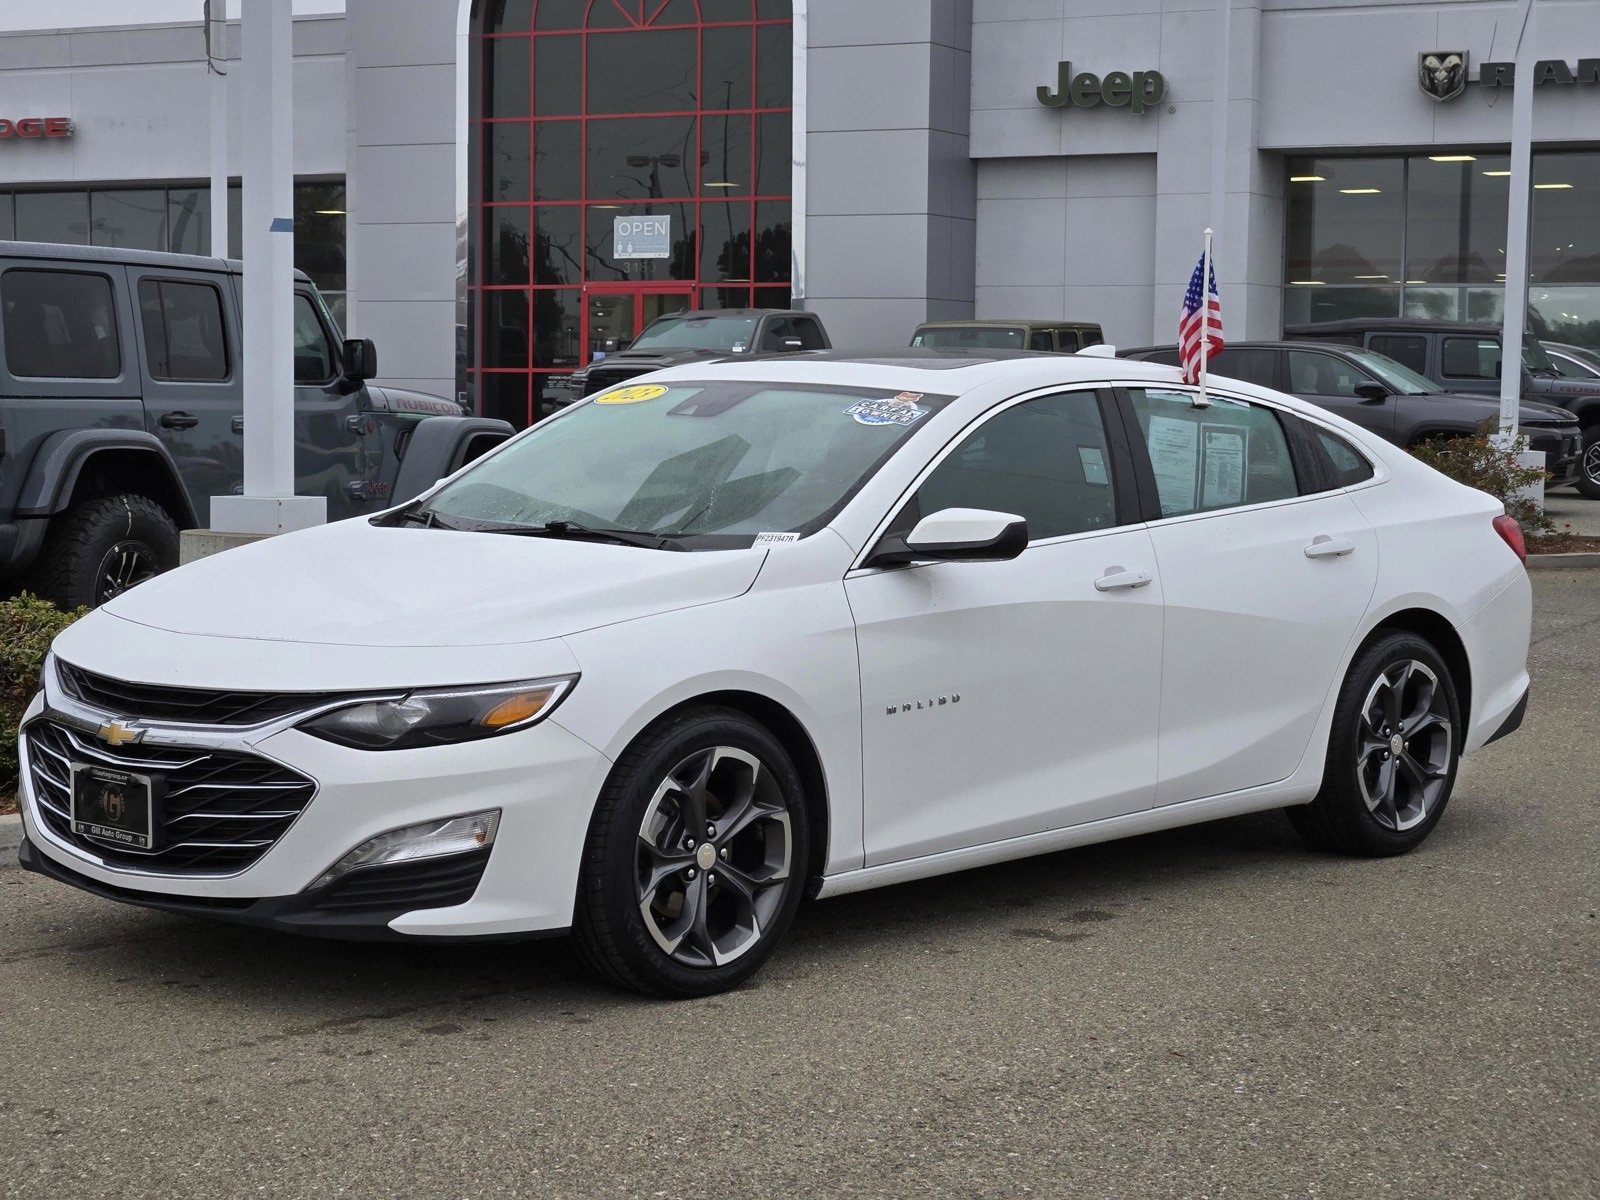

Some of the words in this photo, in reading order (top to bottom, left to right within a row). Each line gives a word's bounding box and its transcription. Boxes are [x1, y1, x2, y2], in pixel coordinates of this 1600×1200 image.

[1036, 61, 1165, 114] Jeep
[619, 221, 666, 236] OPEN
[395, 399, 461, 415] RUBICON
[860, 401, 919, 418] CARFAX
[886, 694, 960, 715] MALIBU
[91, 825, 101, 835] Gill
[101, 828, 115, 838] Auto
[115, 831, 133, 842] Group
